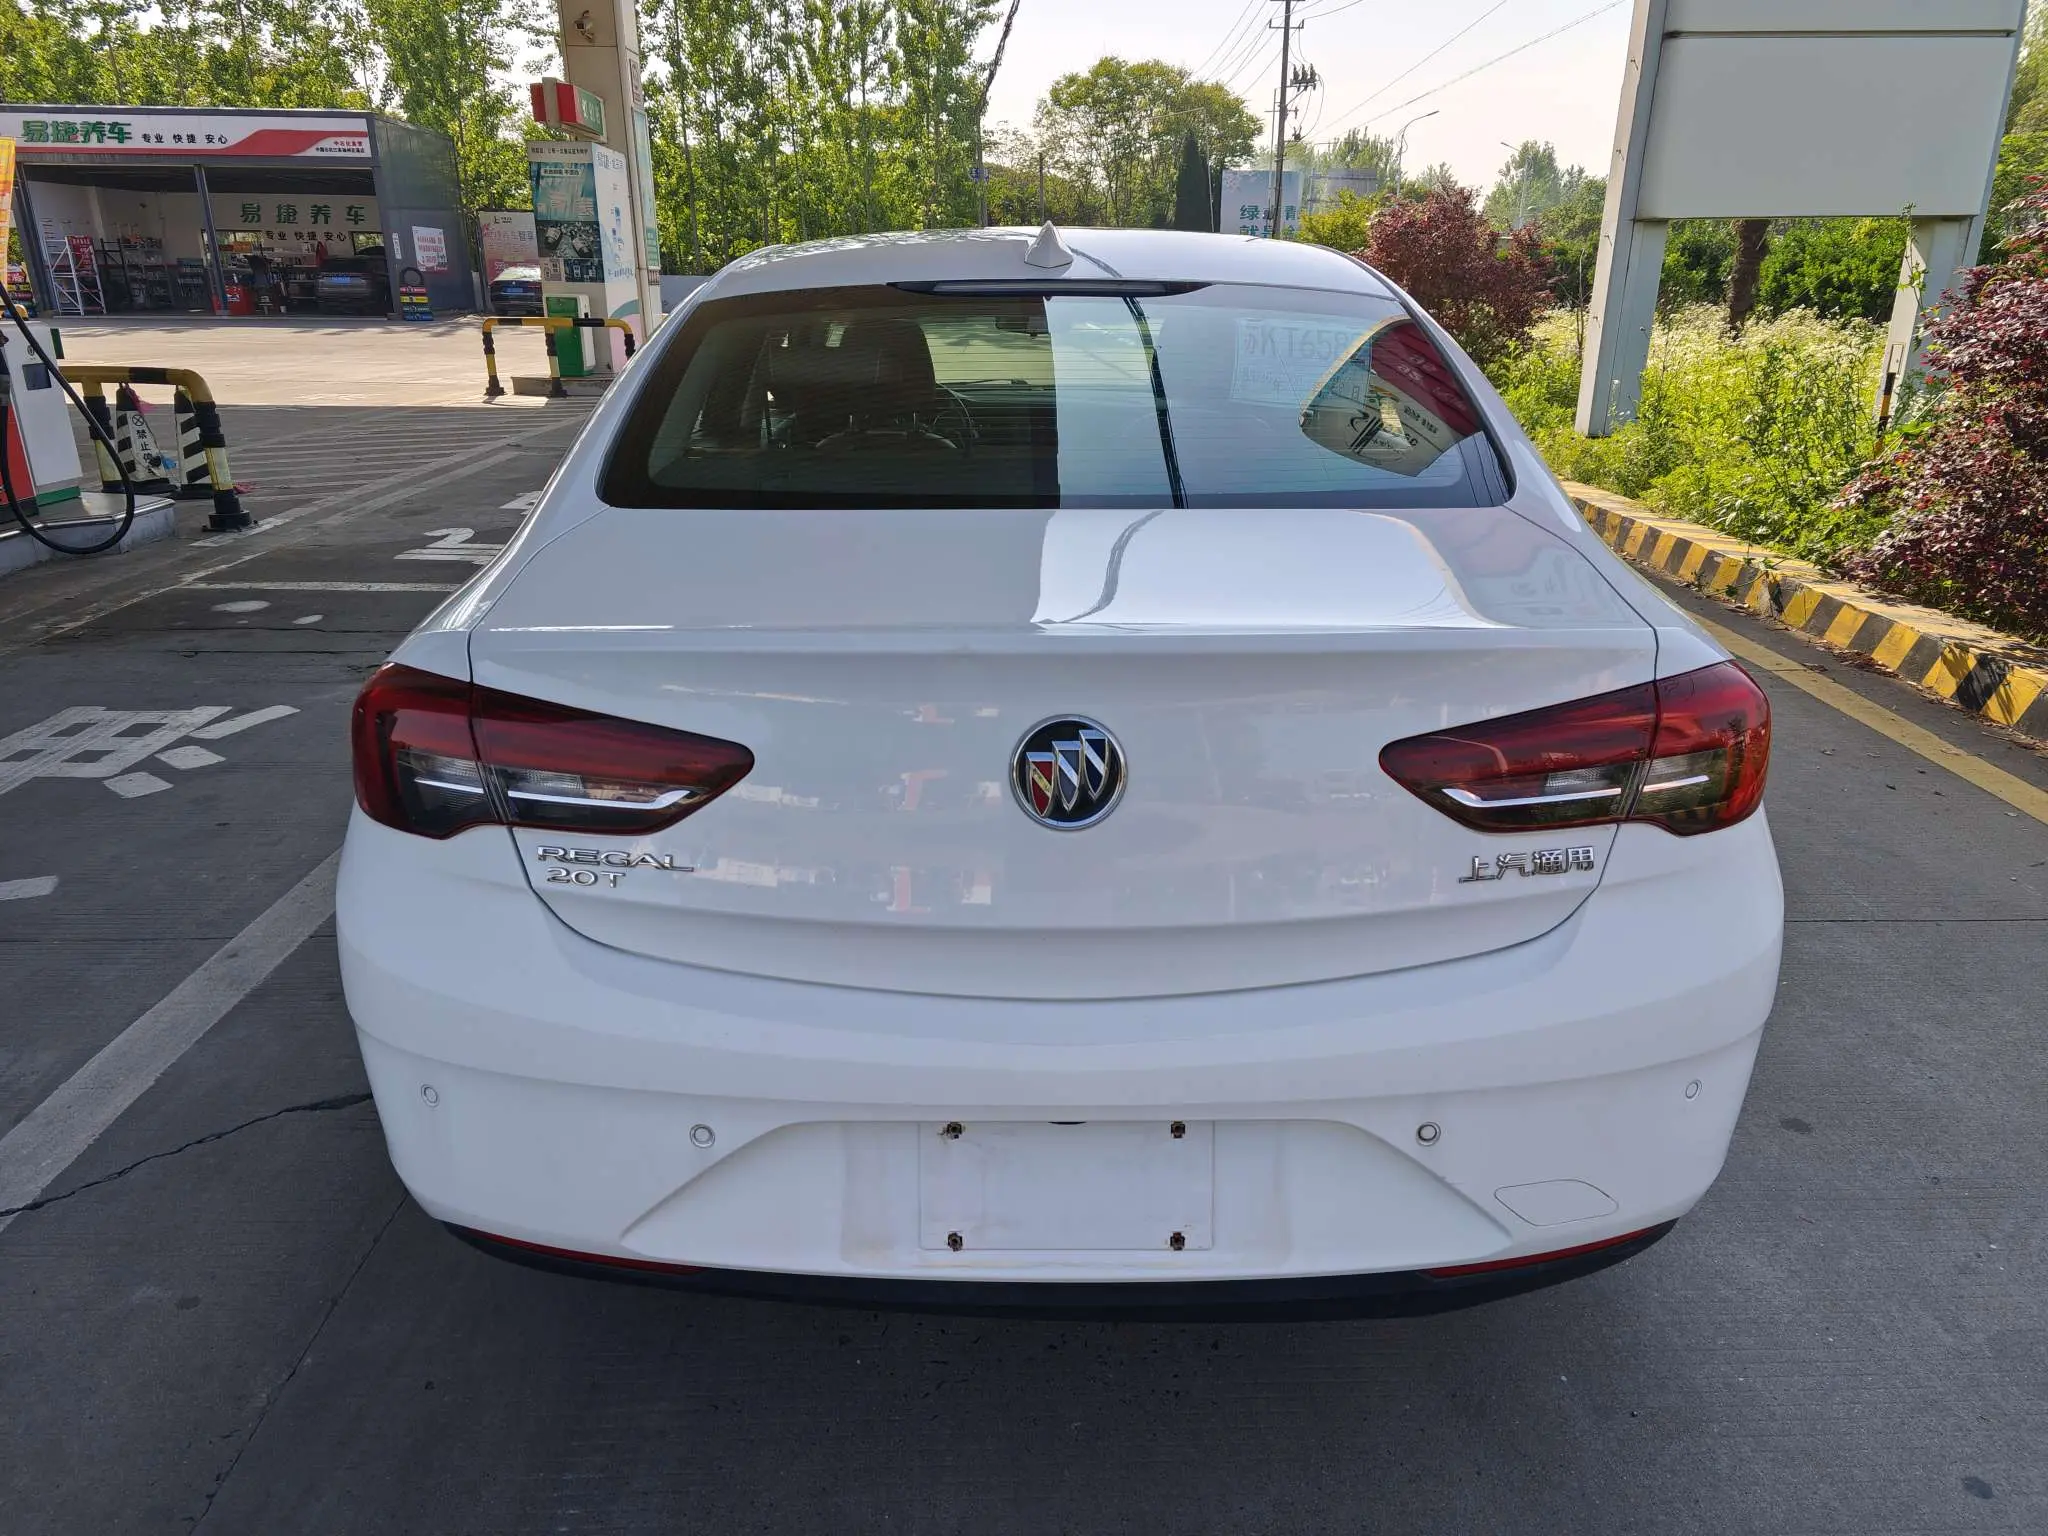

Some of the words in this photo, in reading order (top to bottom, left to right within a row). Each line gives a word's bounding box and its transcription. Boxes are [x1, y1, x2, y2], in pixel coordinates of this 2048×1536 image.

[21, 120, 132, 144] 易捷养车
[141, 132, 165, 144] 专业
[172, 132, 197, 145] 快捷
[204, 133, 228, 144] 安心
[240, 202, 366, 225] 易捷养车
[265, 230, 287, 241] 专业
[294, 230, 318, 241] 快捷
[324, 230, 346, 242] 安心
[537, 845, 695, 872] REGAL
[1458, 845, 1594, 884] 上汽通用
[547, 867, 626, 888] 20T
